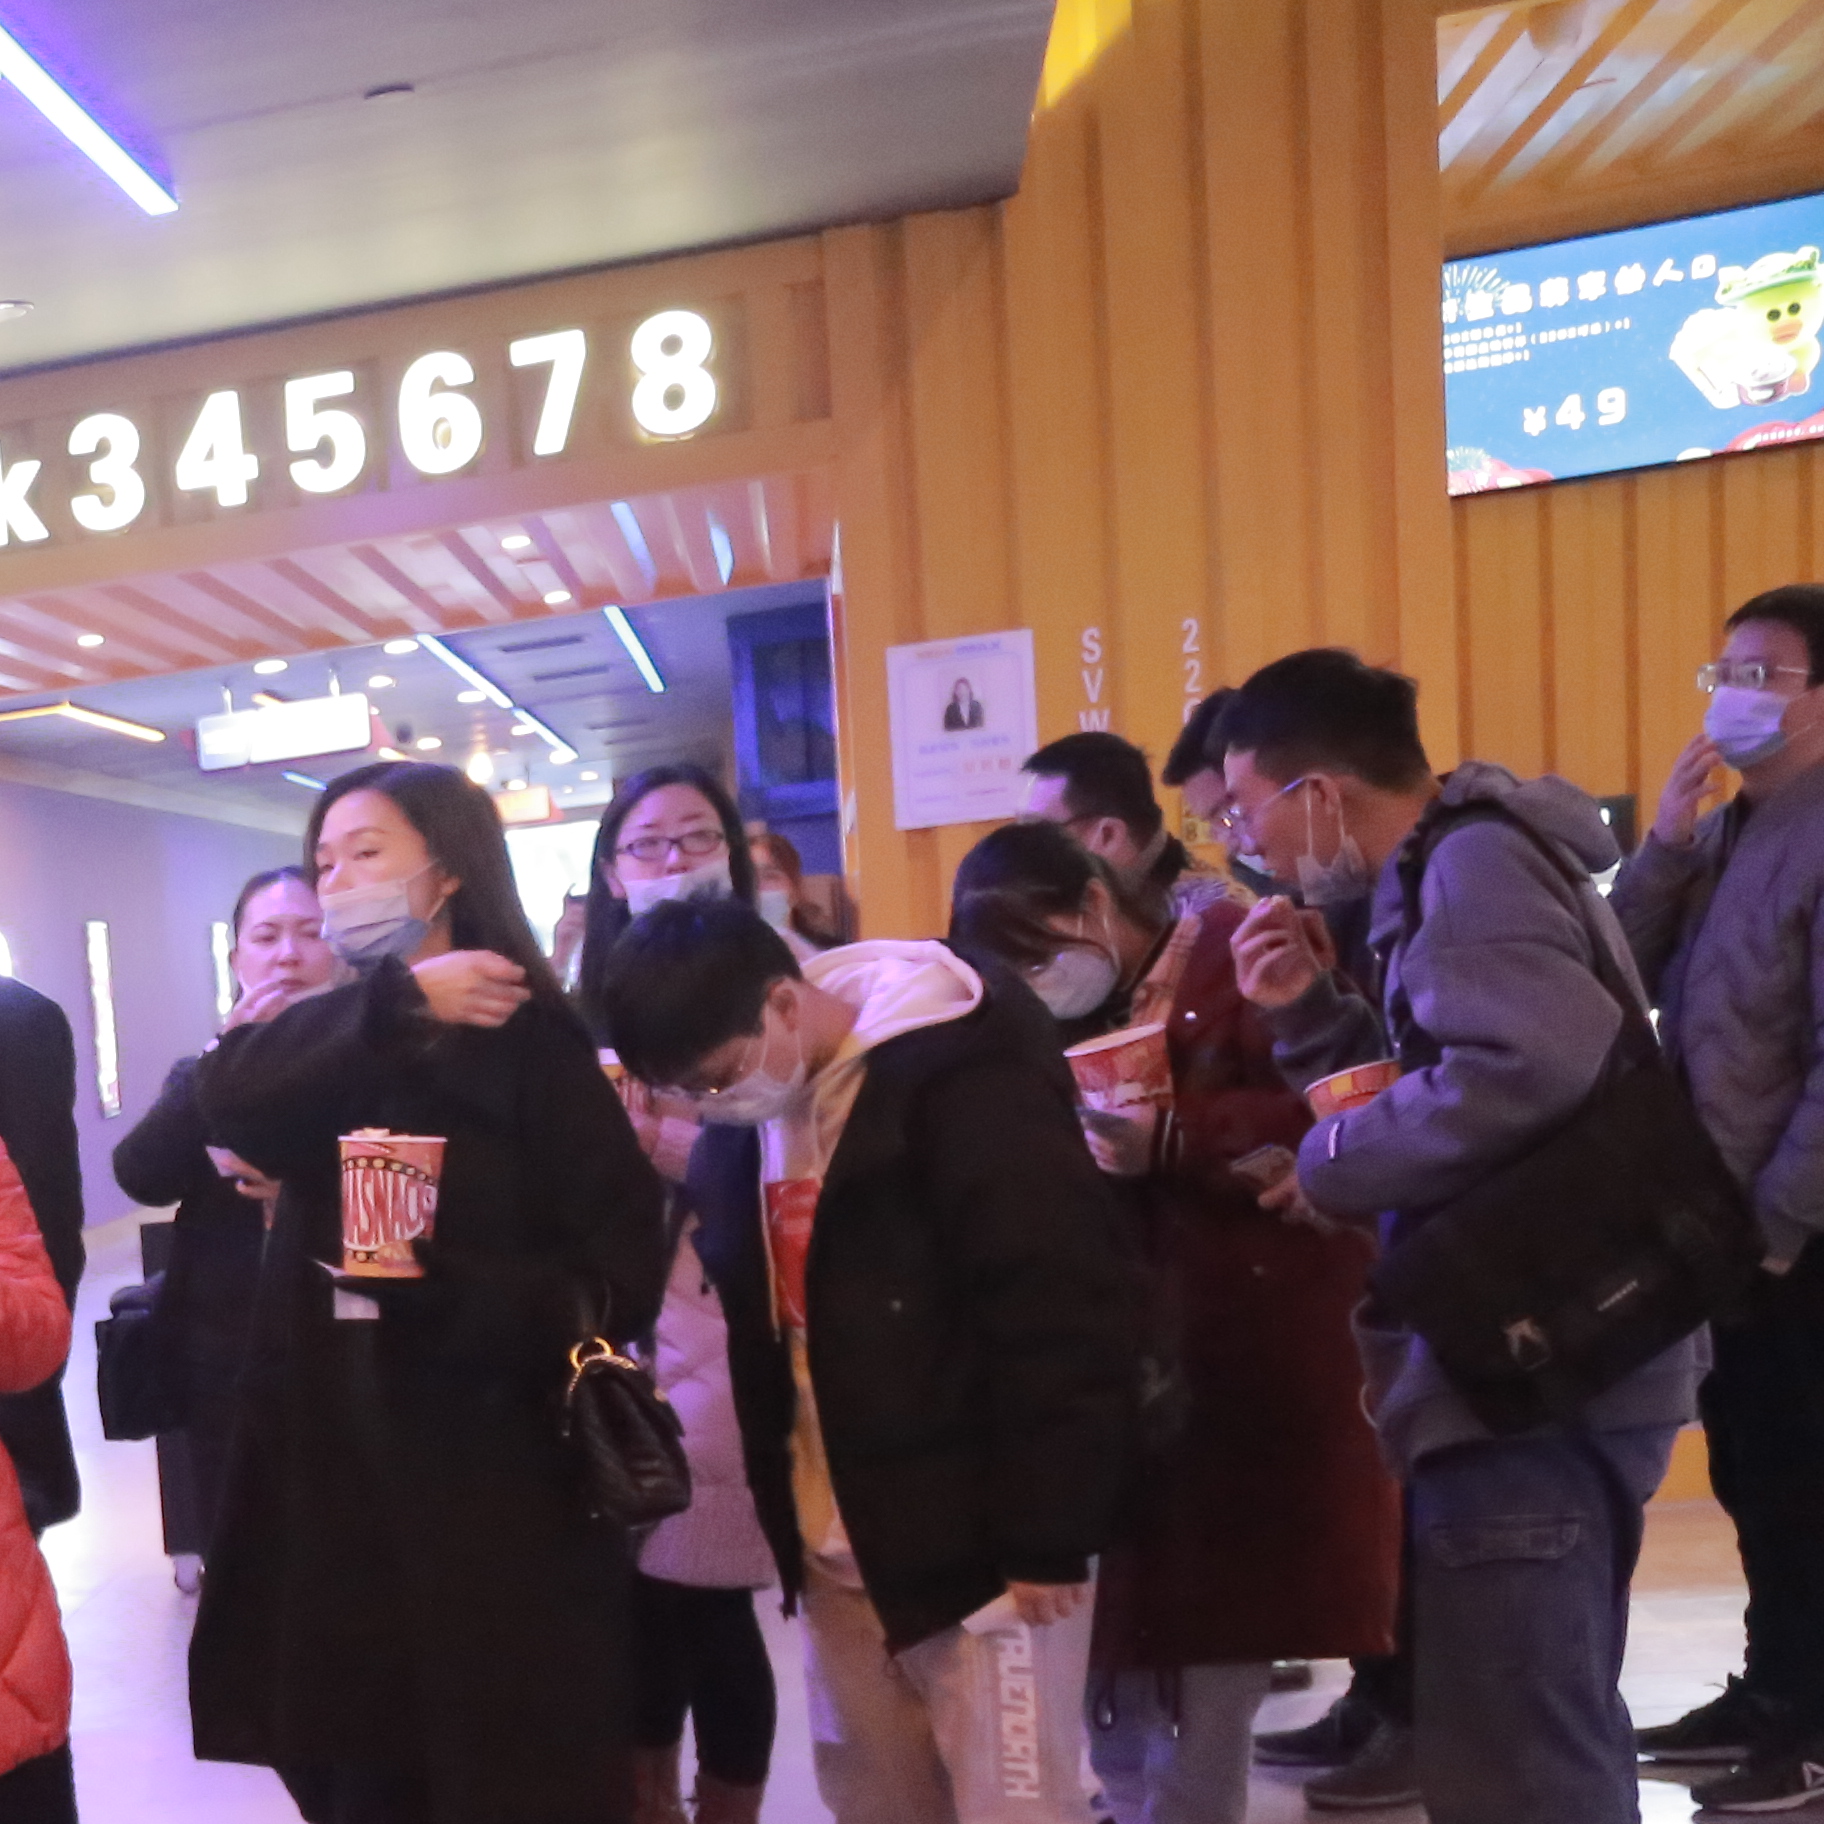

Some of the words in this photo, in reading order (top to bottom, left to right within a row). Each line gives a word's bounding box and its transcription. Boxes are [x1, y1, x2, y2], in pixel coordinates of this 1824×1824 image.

[68, 412, 146, 533] 3
[175, 389, 260, 508] 4
[284, 370, 367, 494] 5
[397, 351, 483, 475] 6
[509, 328, 587, 456] 7
[630, 309, 718, 437] 8
